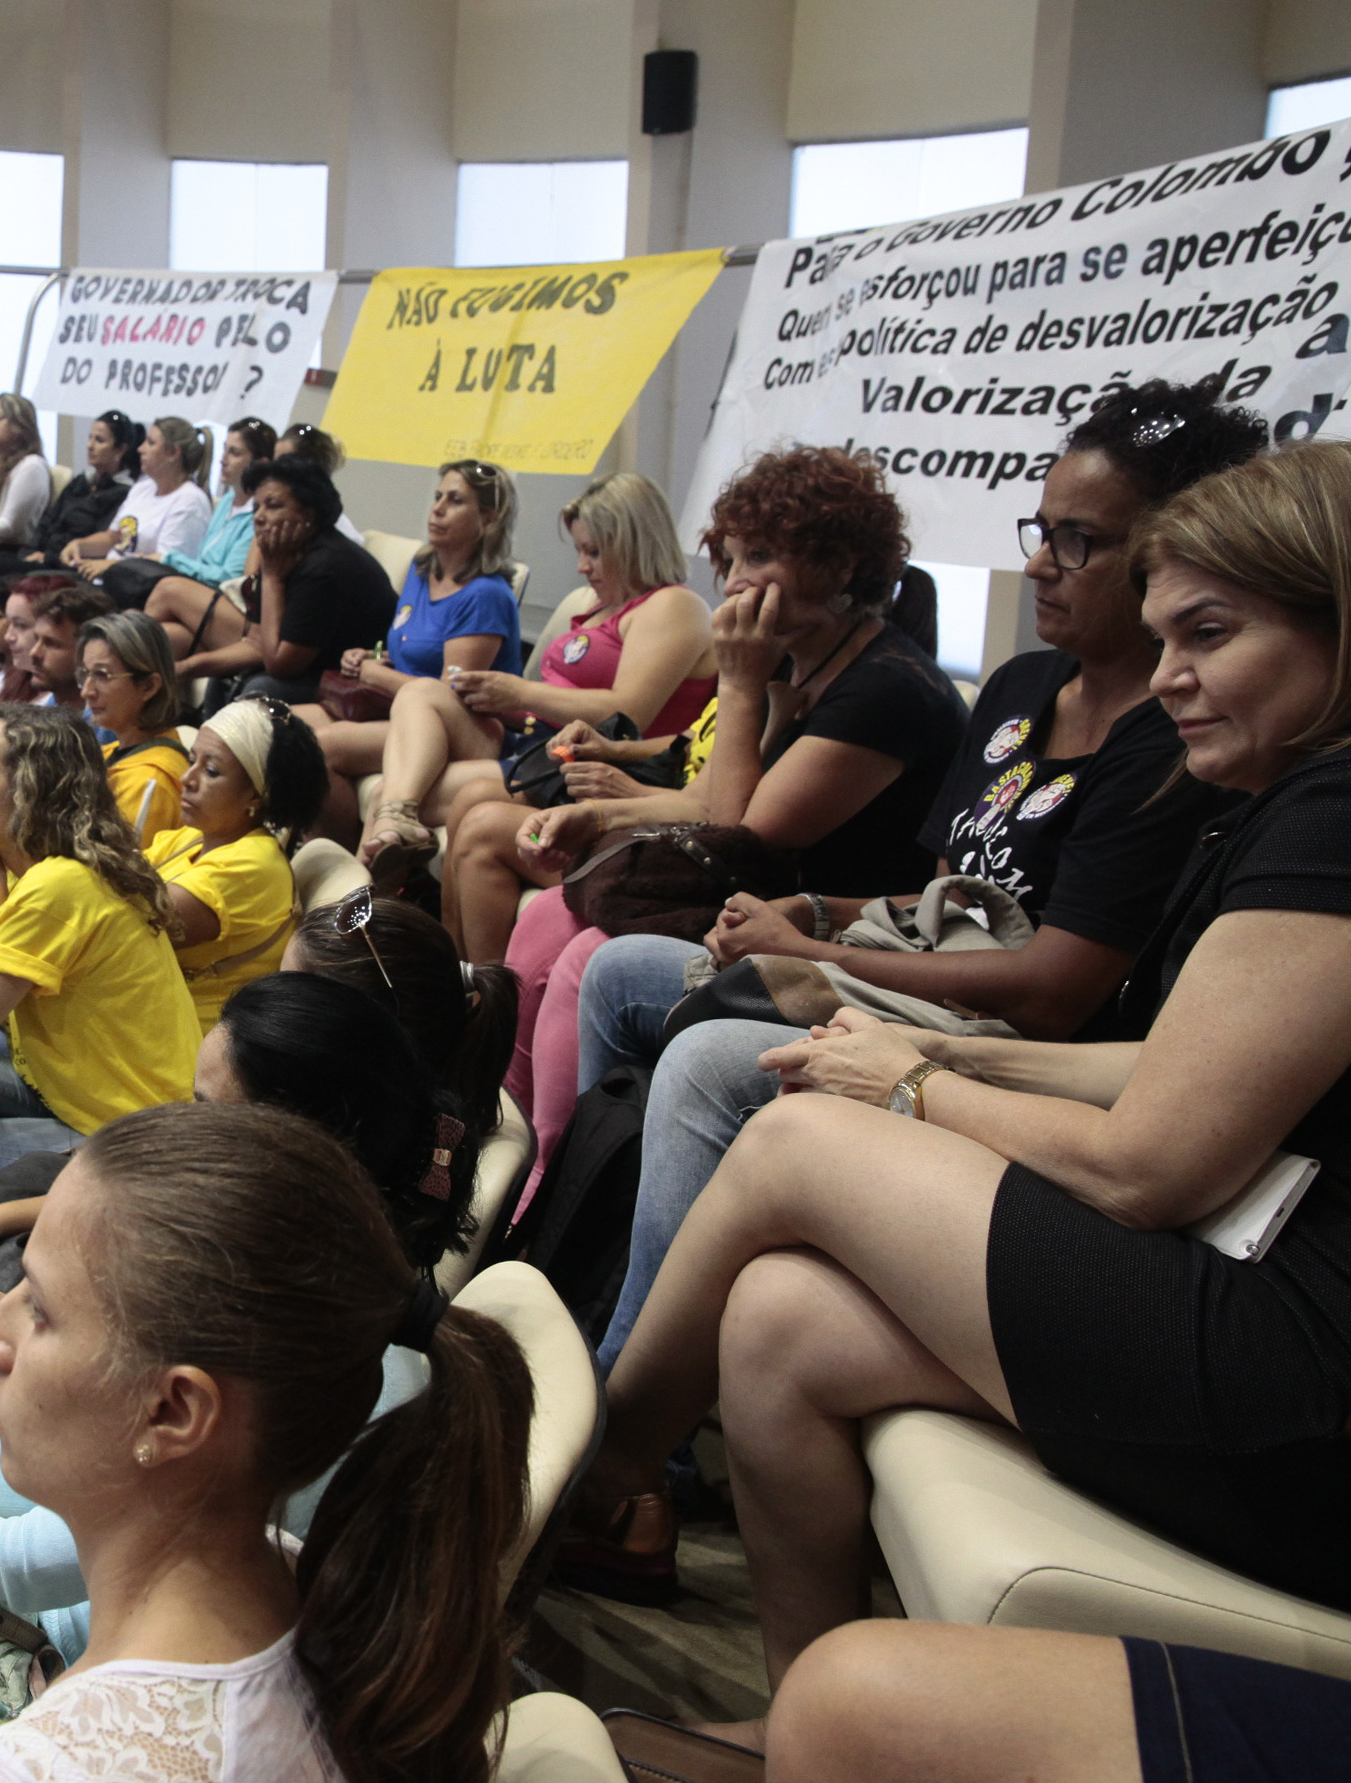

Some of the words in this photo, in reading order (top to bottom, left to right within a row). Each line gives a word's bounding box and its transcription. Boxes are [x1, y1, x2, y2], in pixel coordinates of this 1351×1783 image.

[853, 237, 885, 260] o
[885, 197, 1064, 253] Governo
[1070, 129, 1332, 222] Colombo
[70, 275, 227, 305] GOVERNADOR
[986, 250, 1068, 304] para
[1079, 242, 1128, 283] se
[386, 281, 448, 331] NÃO
[449, 271, 631, 319] FUGIMOS
[58, 315, 98, 345] SEU
[763, 357, 815, 391] Com
[834, 315, 957, 367] política
[963, 314, 1009, 355] de
[1015, 274, 1339, 352] desvalorização
[59, 356, 94, 386] DO
[454, 343, 558, 394] LUTA
